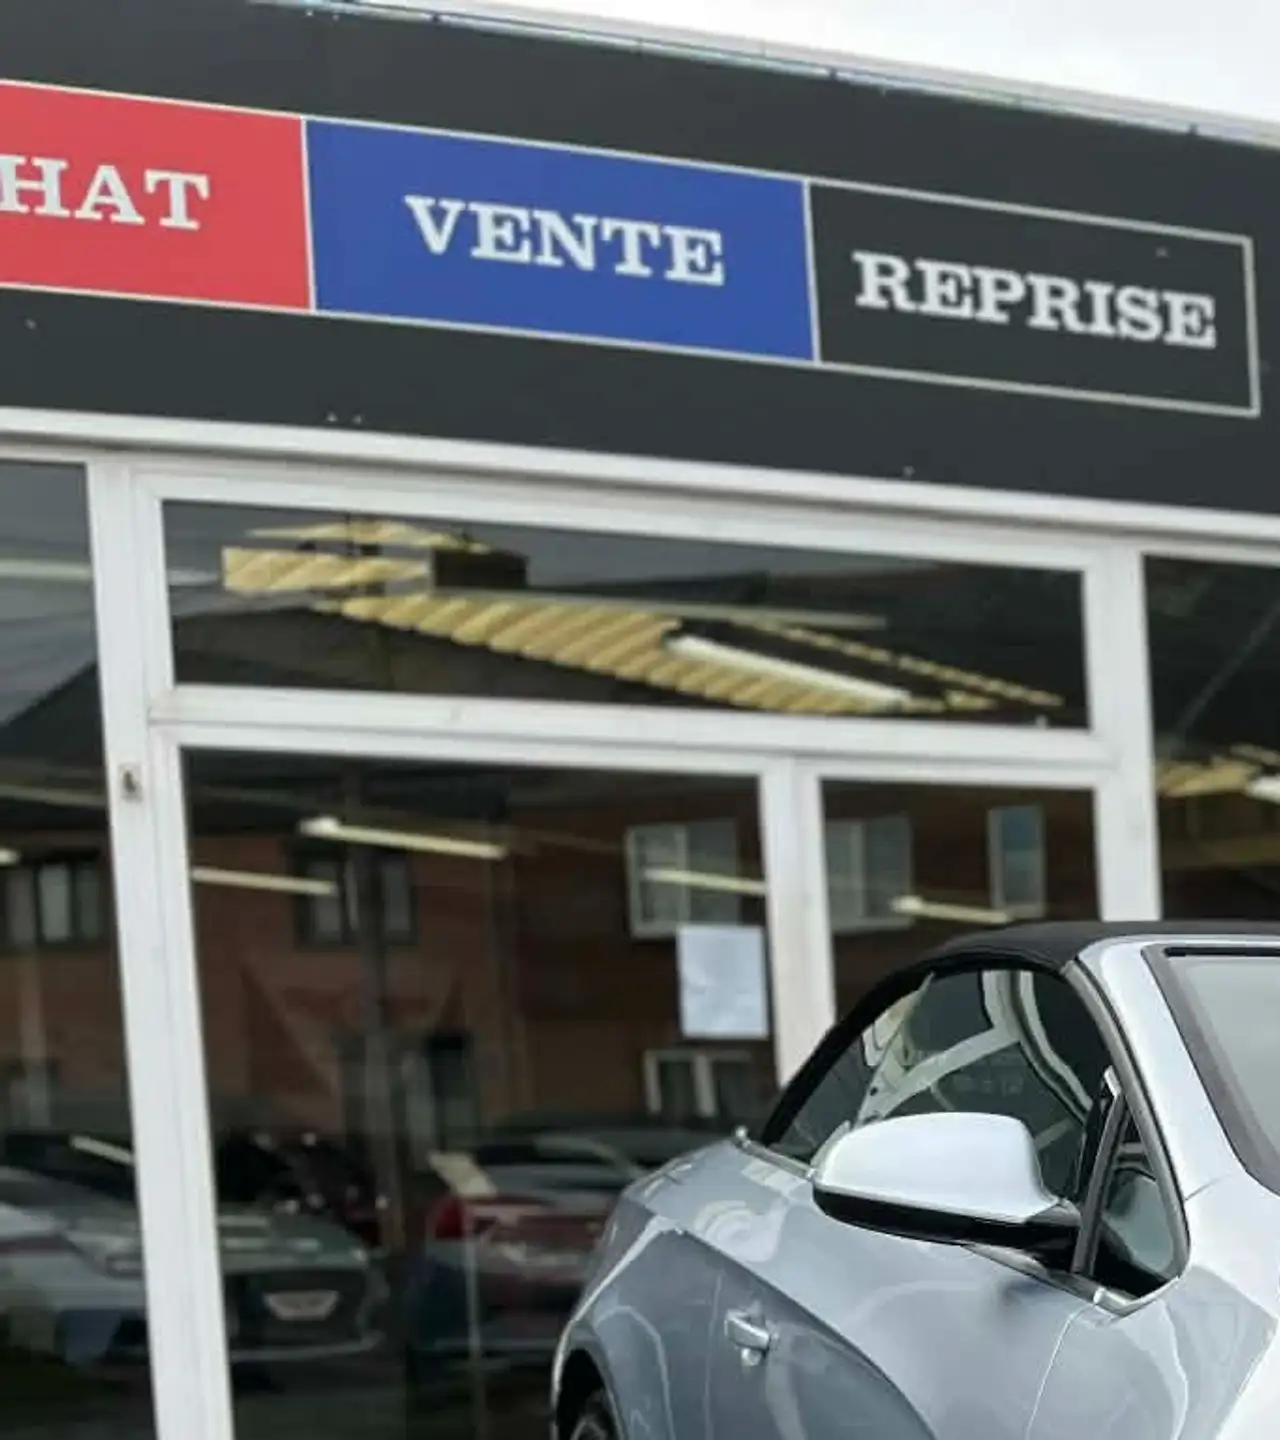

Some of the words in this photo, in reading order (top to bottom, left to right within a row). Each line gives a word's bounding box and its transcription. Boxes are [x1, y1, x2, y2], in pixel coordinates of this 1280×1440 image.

[0, 154, 210, 231] HAT
[404, 195, 724, 286] VENTE
[851, 250, 1217, 349] REPRISE
